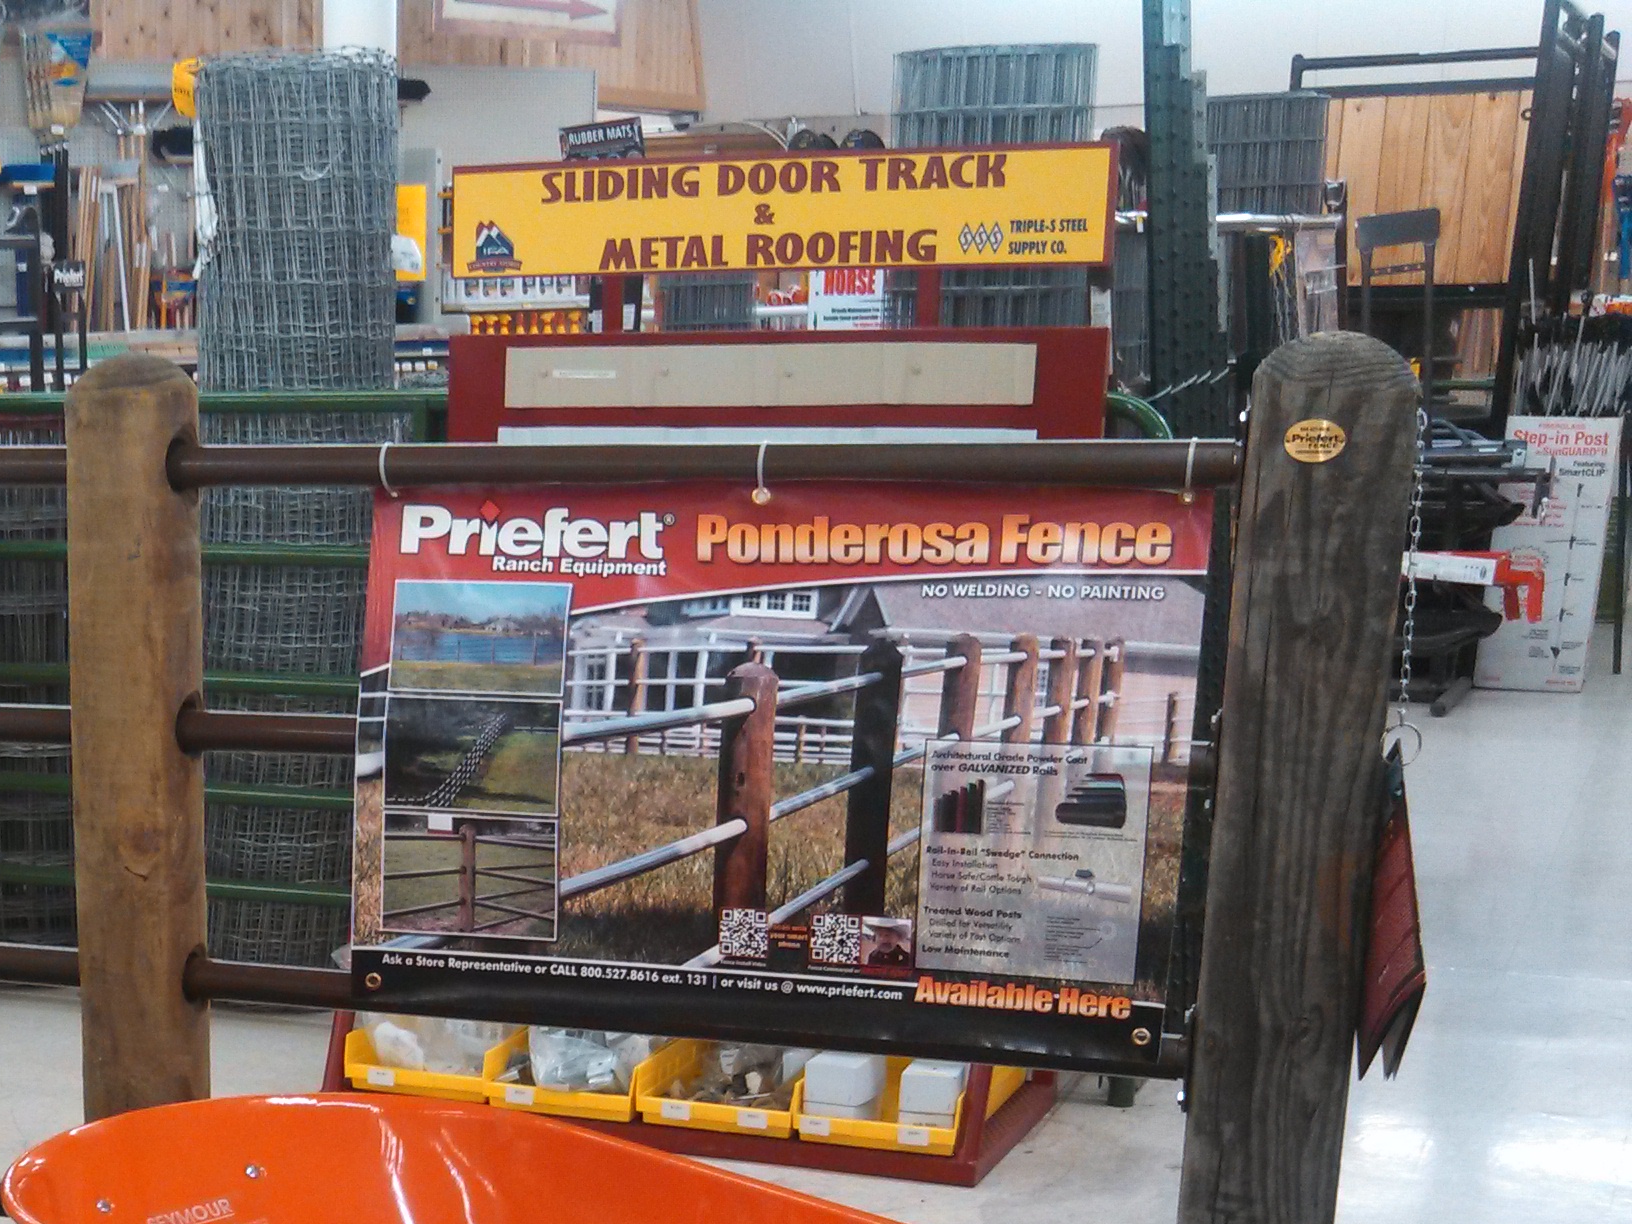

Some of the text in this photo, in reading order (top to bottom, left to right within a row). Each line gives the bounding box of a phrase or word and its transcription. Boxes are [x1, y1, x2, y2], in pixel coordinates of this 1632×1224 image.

[568, 124, 632, 146] RUBBER MATS
[541, 154, 1007, 204] SLIDING DOOR TRACK
[753, 203, 775, 225] &
[1009, 218, 1088, 233] TRIPLE-S STEEL
[599, 229, 937, 271] METAL ROOFING
[1008, 240, 1067, 255] SUPPLY CO.
[1291, 432, 1338, 442] Priefert
[1514, 429, 1610, 447] Step-in Post
[1558, 467, 1606, 478] SmartCLIP
[695, 513, 1174, 567] Ponderosa Fence
[492, 556, 667, 578] Ranch Equipment
[921, 584, 947, 599] NO
[952, 583, 1031, 599] WELDING
[1047, 584, 1076, 599] NO
[1079, 584, 1166, 601] PAINTING
[931, 750, 1088, 765] Architectural Grade Powder Coat
[930, 762, 1059, 777] over GALVANIZED Rails
[1028, 850, 1080, 862] Connection
[931, 858, 998, 870] Easy Installation
[931, 870, 956, 881] Horse
[970, 884, 987, 895] Rail
[923, 905, 963, 917] Treated
[964, 907, 993, 918] Wood
[921, 945, 942, 956] Low
[381, 952, 403, 966] Ask
[405, 956, 413, 967] a
[415, 954, 446, 968] Store
[447, 956, 532, 975] Representative
[533, 964, 548, 975] or
[549, 963, 578, 977] CALL
[579, 966, 659, 984] 800.527.8616
[661, 972, 683, 985] ext.
[686, 973, 708, 986] 131
[720, 977, 735, 989] or
[736, 976, 762, 990] visit
[764, 980, 778, 991] us
[780, 979, 794, 994] @
[796, 982, 904, 1001] www.priefert.com
[914, 975, 1133, 1021] Available Here
